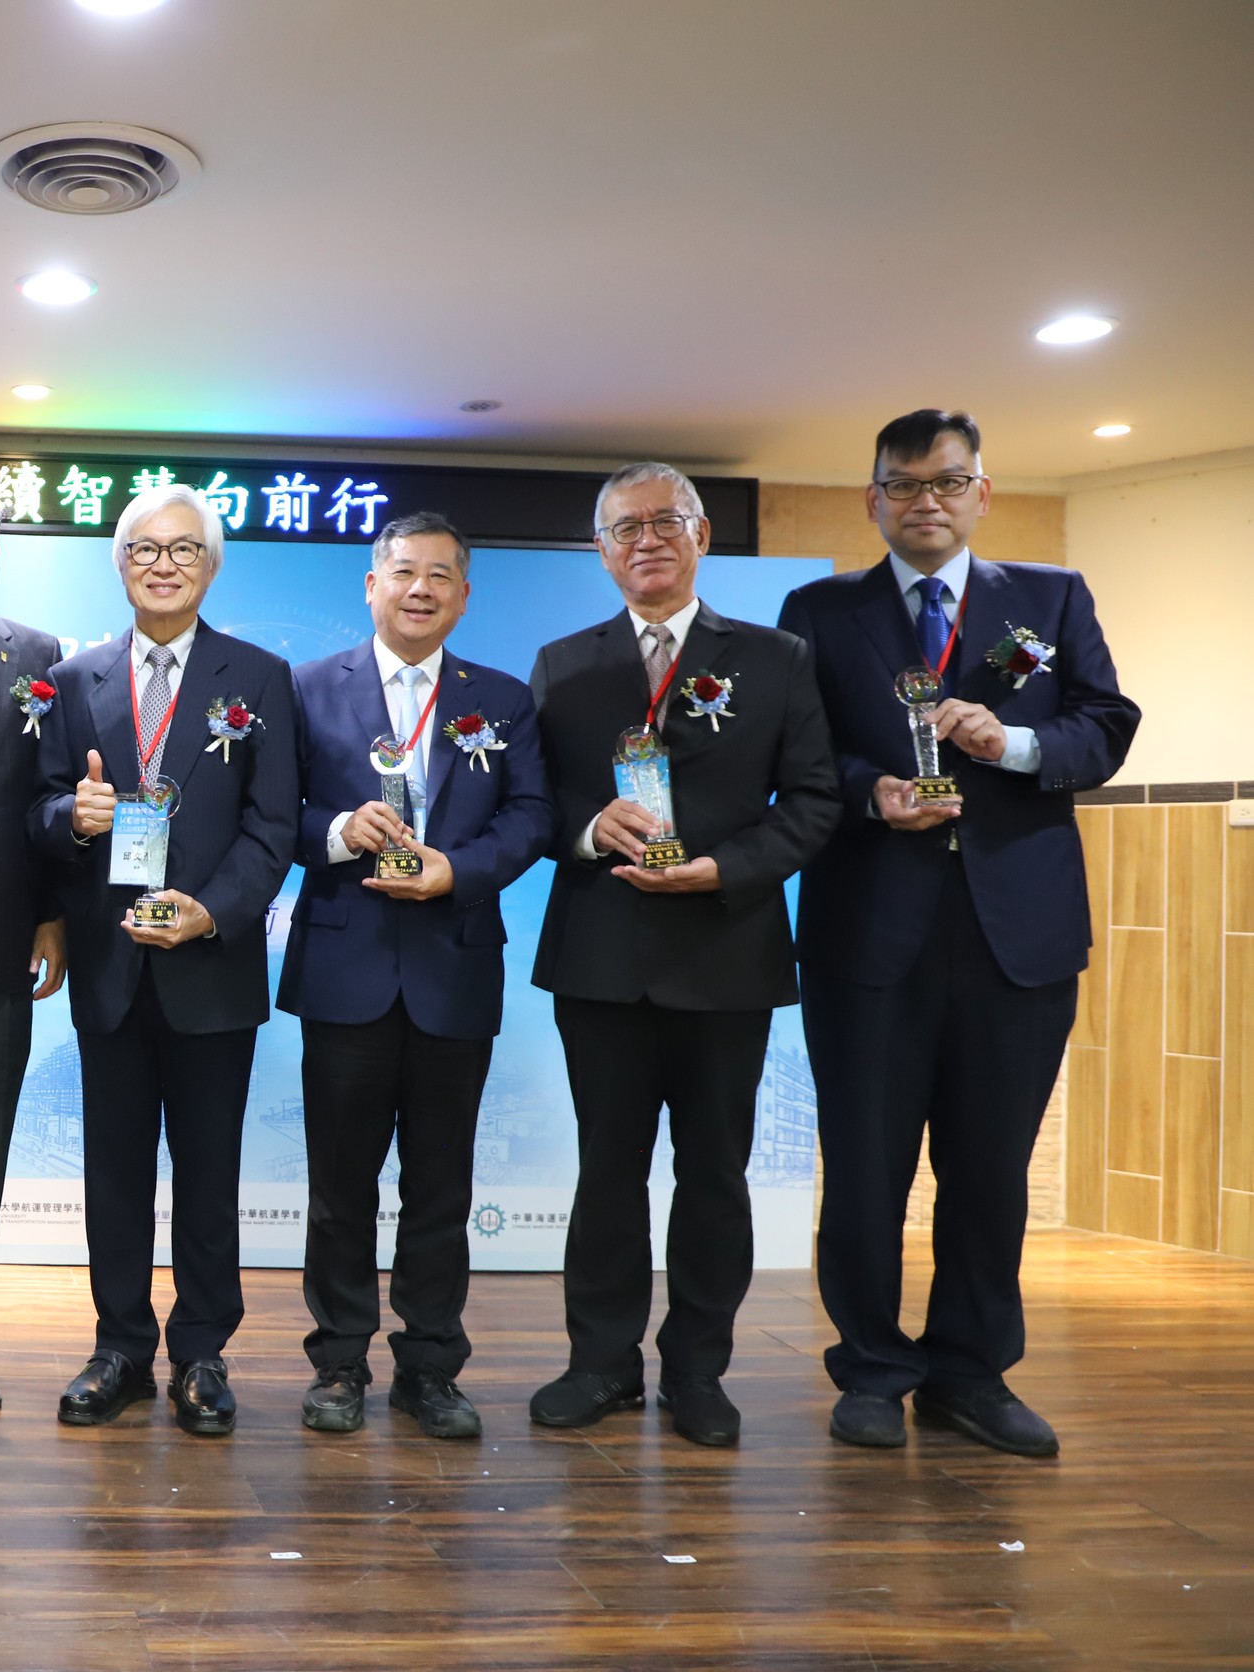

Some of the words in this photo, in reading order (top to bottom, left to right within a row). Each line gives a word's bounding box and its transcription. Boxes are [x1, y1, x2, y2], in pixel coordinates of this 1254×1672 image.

[238, 1208, 301, 1219] 中華航運學會
